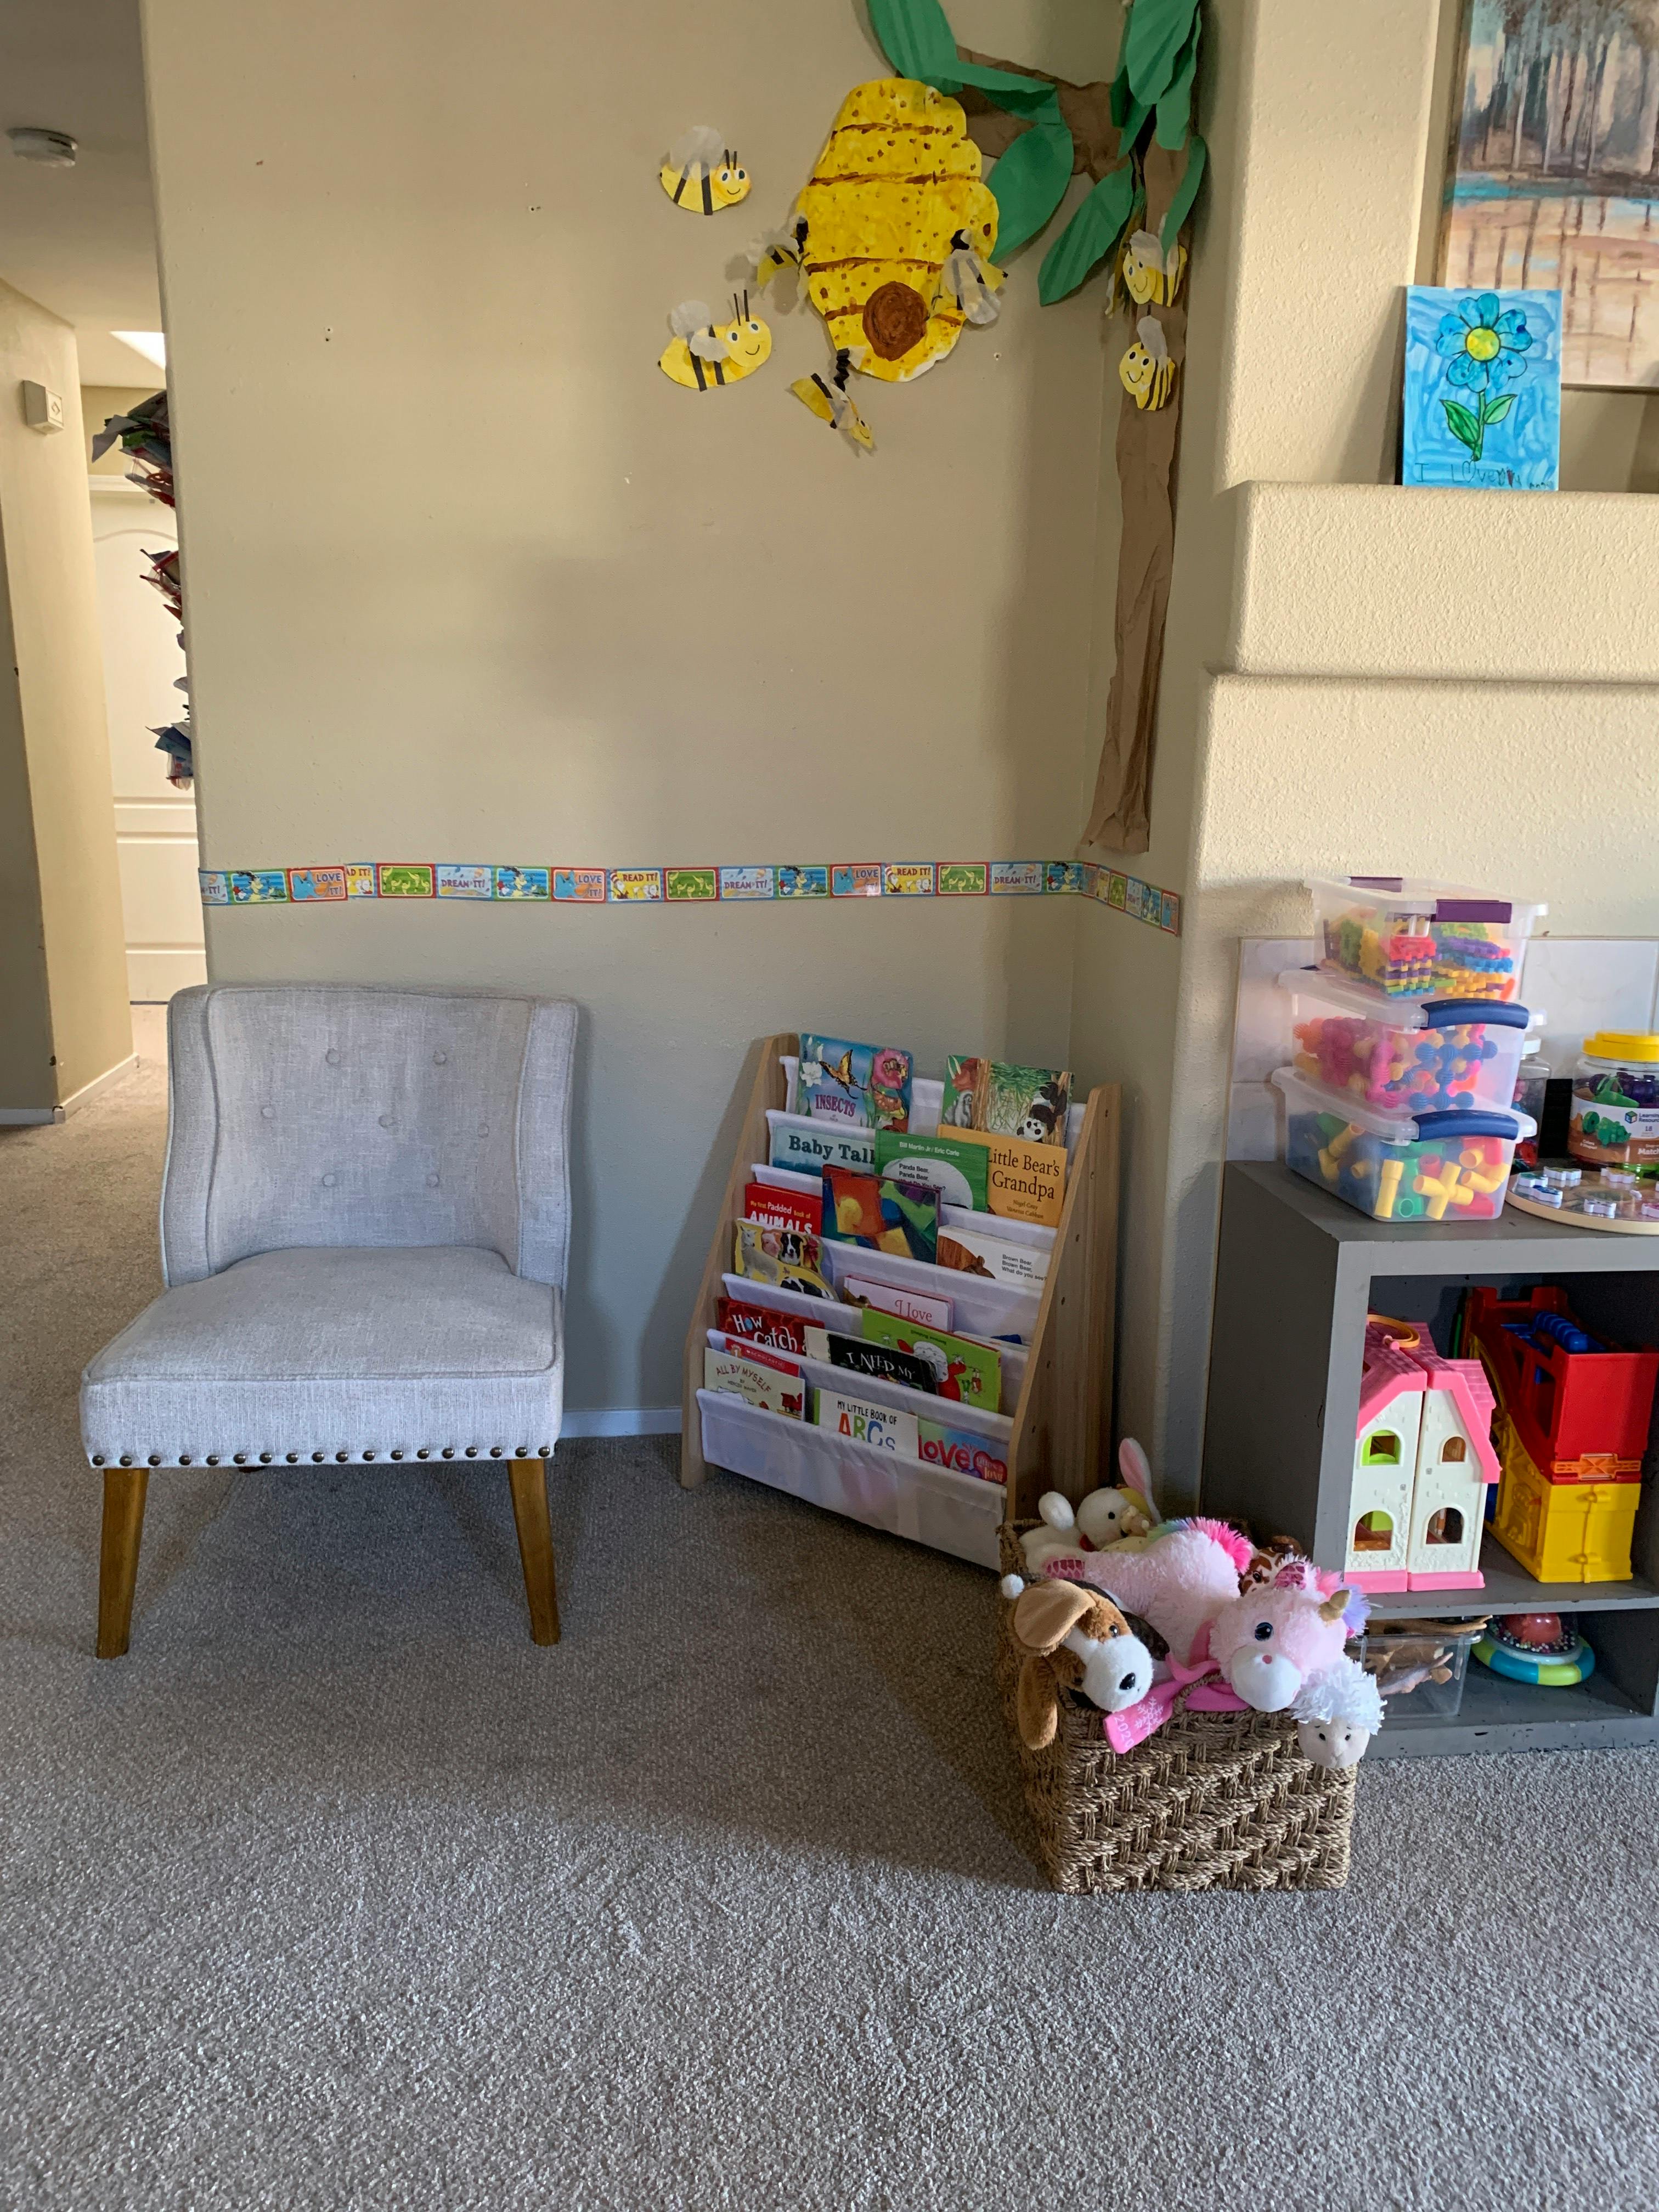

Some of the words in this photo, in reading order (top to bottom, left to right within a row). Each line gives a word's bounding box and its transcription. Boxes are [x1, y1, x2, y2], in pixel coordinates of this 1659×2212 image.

[1415, 462, 1429, 482] I
[358, 867, 370, 876] IT!
[646, 872, 658, 881] IT!
[856, 869, 878, 878] LOVE
[920, 867, 930, 876] IT!
[316, 872, 342, 883] LOVE
[578, 874, 602, 883] LOVE
[1024, 874, 1036, 884] IT!
[208, 884, 220, 894] IT!
[441, 879, 469, 888] DREAM
[473, 879, 486, 888] IT!
[755, 879, 768, 889] IT!
[329, 885, 343, 895] IT!
[588, 888, 601, 897] IT!
[815, 1094, 856, 1118] INSECTS
[788, 1135, 834, 1161] Baby
[909, 1143, 925, 1151] Martin
[899, 1163, 915, 1171] Panda
[1022, 1154, 1060, 1177] Bear's
[899, 1171, 915, 1179] Panda
[992, 1170, 1055, 1203] Grandpa
[768, 1201, 792, 1214] Padded
[750, 1210, 812, 1234] ANIMALS
[1002, 1254, 1019, 1262] Brown
[1019, 1259, 1032, 1267] Bear,
[1002, 1260, 1018, 1268] Brown
[1019, 1264, 1032, 1273] Bear,
[907, 1302, 932, 1322] love
[845, 1352, 854, 1364] I
[860, 1352, 895, 1372] NEED
[898, 1364, 915, 1379] MY
[716, 1365, 730, 1376] ALL
[730, 1364, 741, 1374] BY
[742, 1367, 771, 1392] MYSELF
[837, 1400, 845, 1411] MY
[847, 1402, 869, 1417] LITTLE
[870, 1409, 887, 1423] BOOK
[889, 1415, 898, 1425] OF
[1114, 1714, 1135, 1749] 2020
